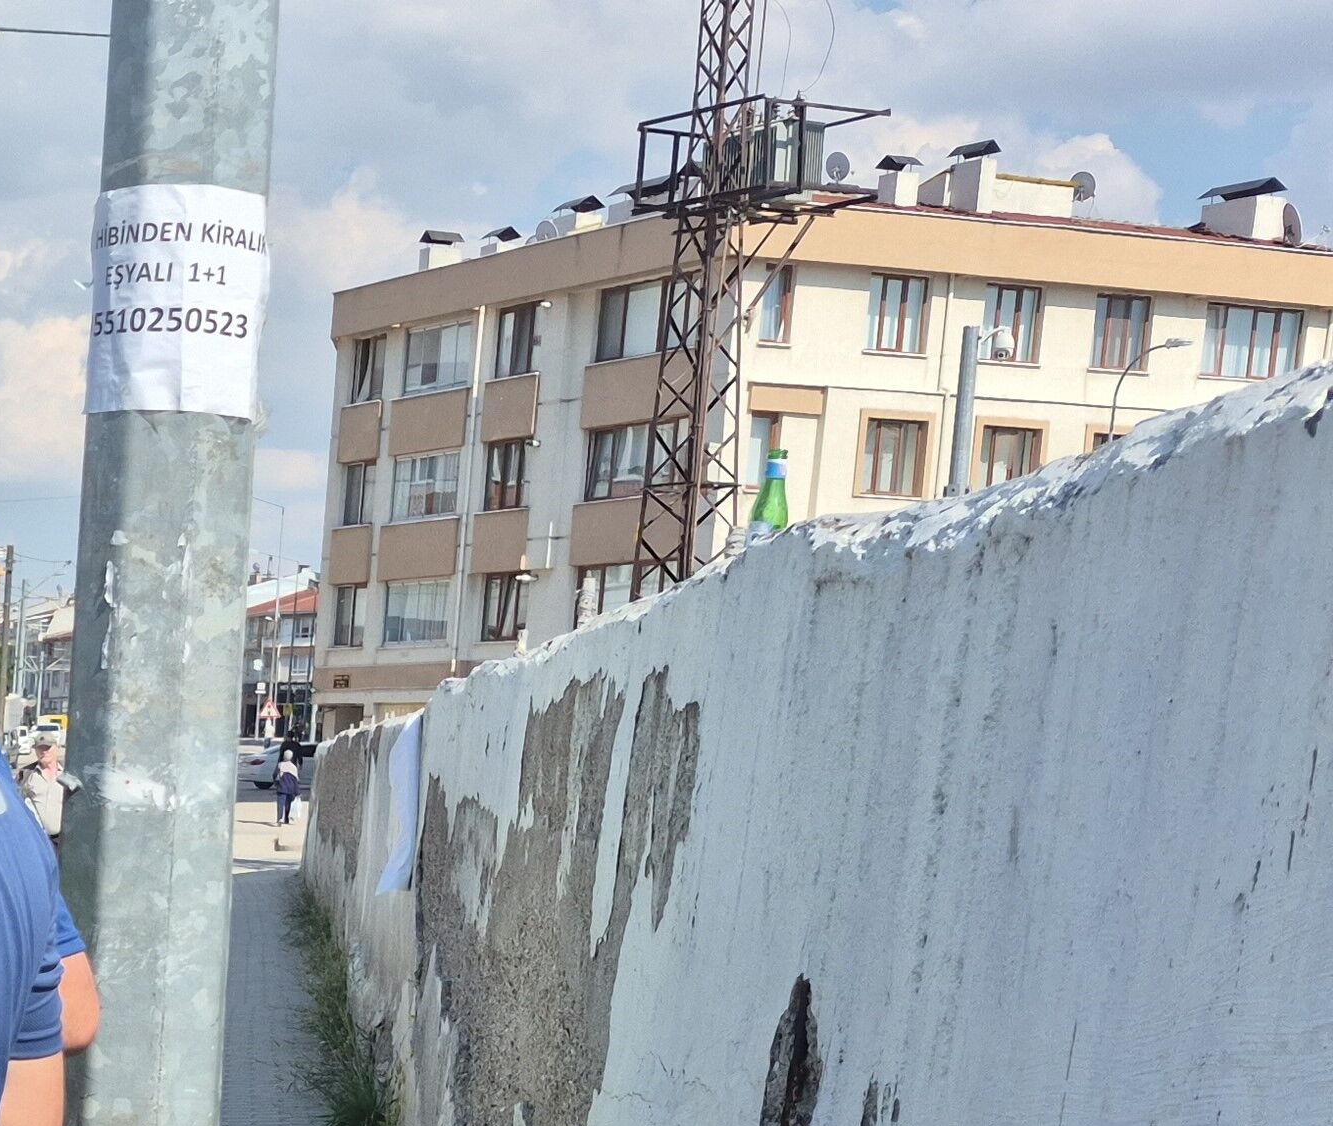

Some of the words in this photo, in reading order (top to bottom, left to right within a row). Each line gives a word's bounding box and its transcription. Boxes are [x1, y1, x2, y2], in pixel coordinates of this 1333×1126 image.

[105, 261, 173, 290] EŞYALI
[188, 262, 227, 286] 1+1
[92, 306, 249, 339] 5510250523
